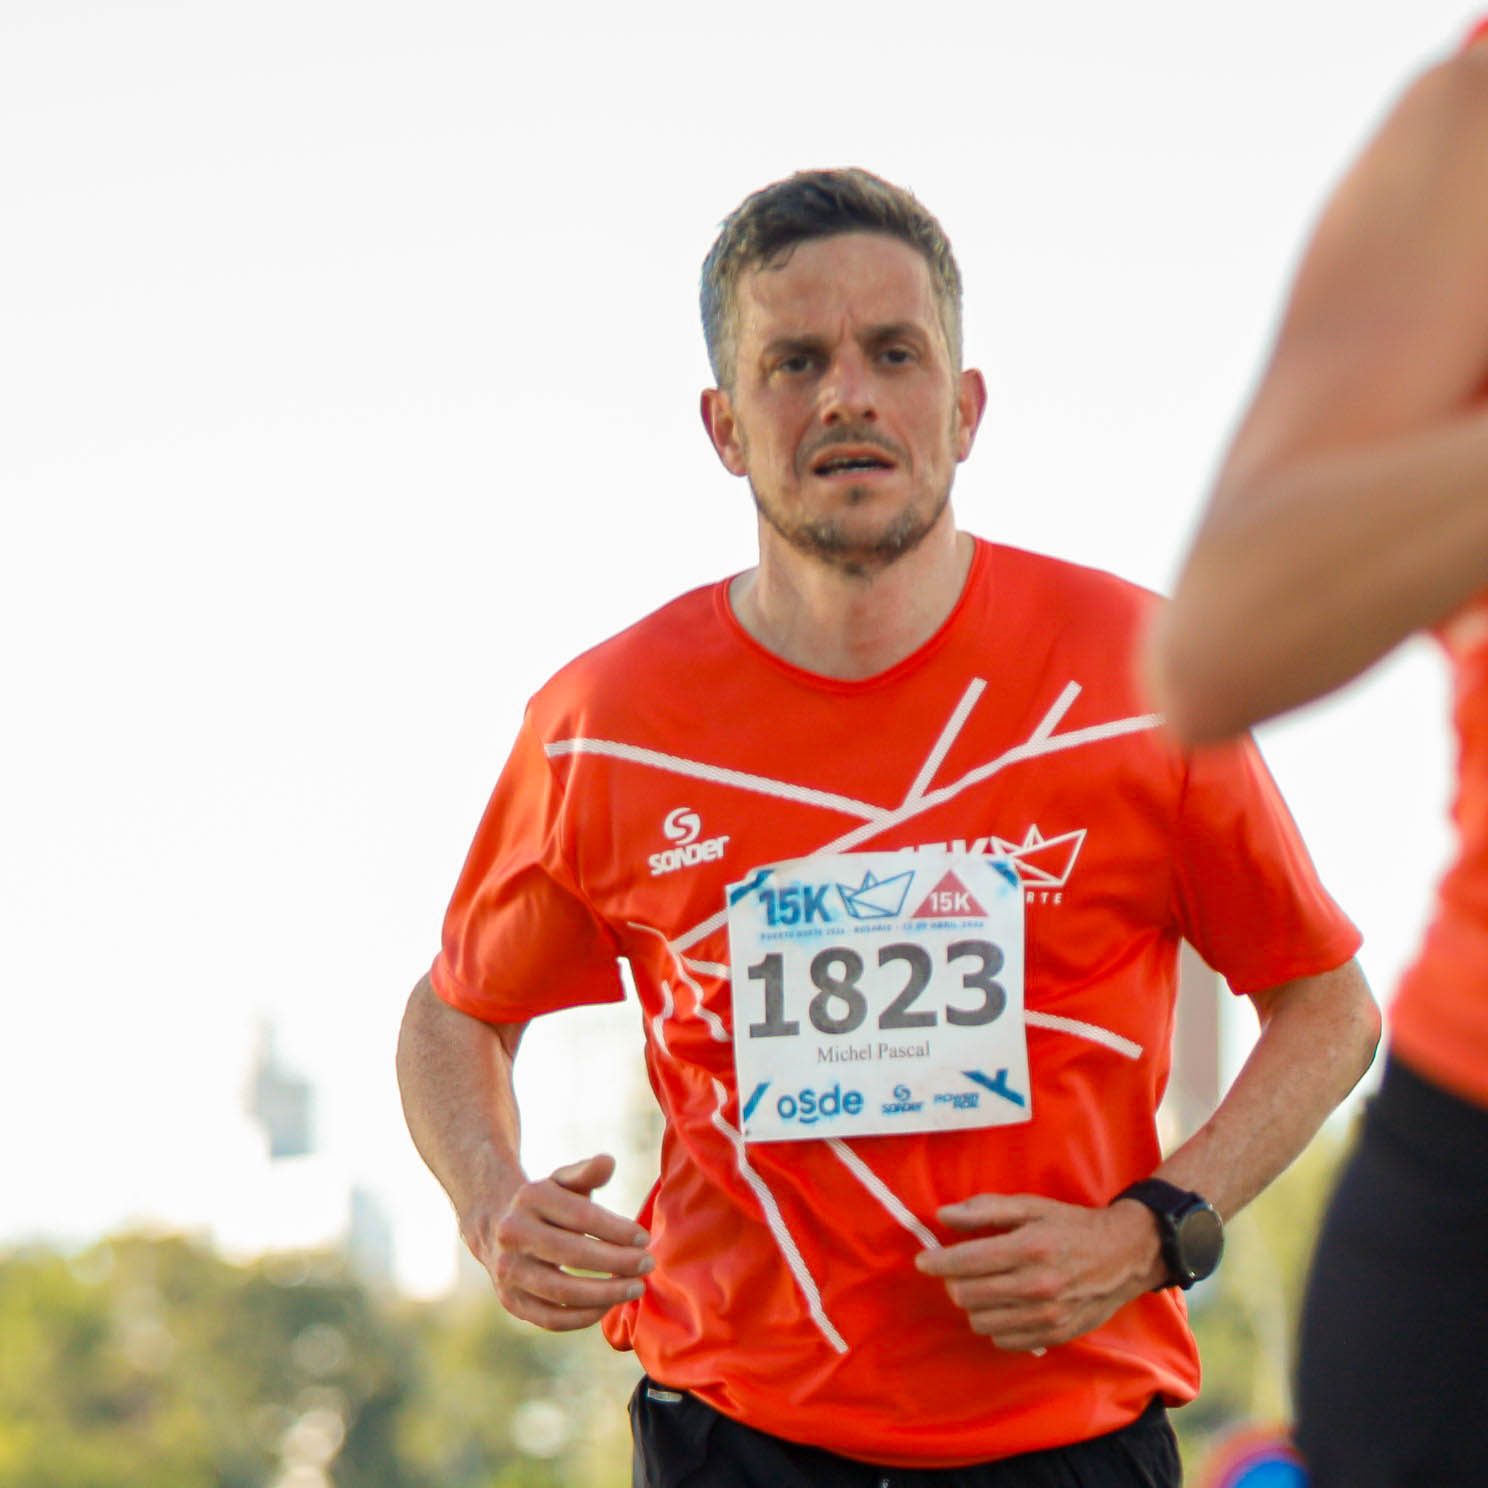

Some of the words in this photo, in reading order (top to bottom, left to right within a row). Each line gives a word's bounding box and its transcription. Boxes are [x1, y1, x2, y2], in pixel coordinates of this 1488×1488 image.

[759, 884, 833, 927] 15K
[929, 891, 973, 913] 15K
[1025, 891, 1064, 906] RTE
[747, 939, 1008, 1039] 1823
[816, 1044, 871, 1064] Michel
[877, 1040, 931, 1061] Pascal
[776, 1084, 864, 1122] osde
